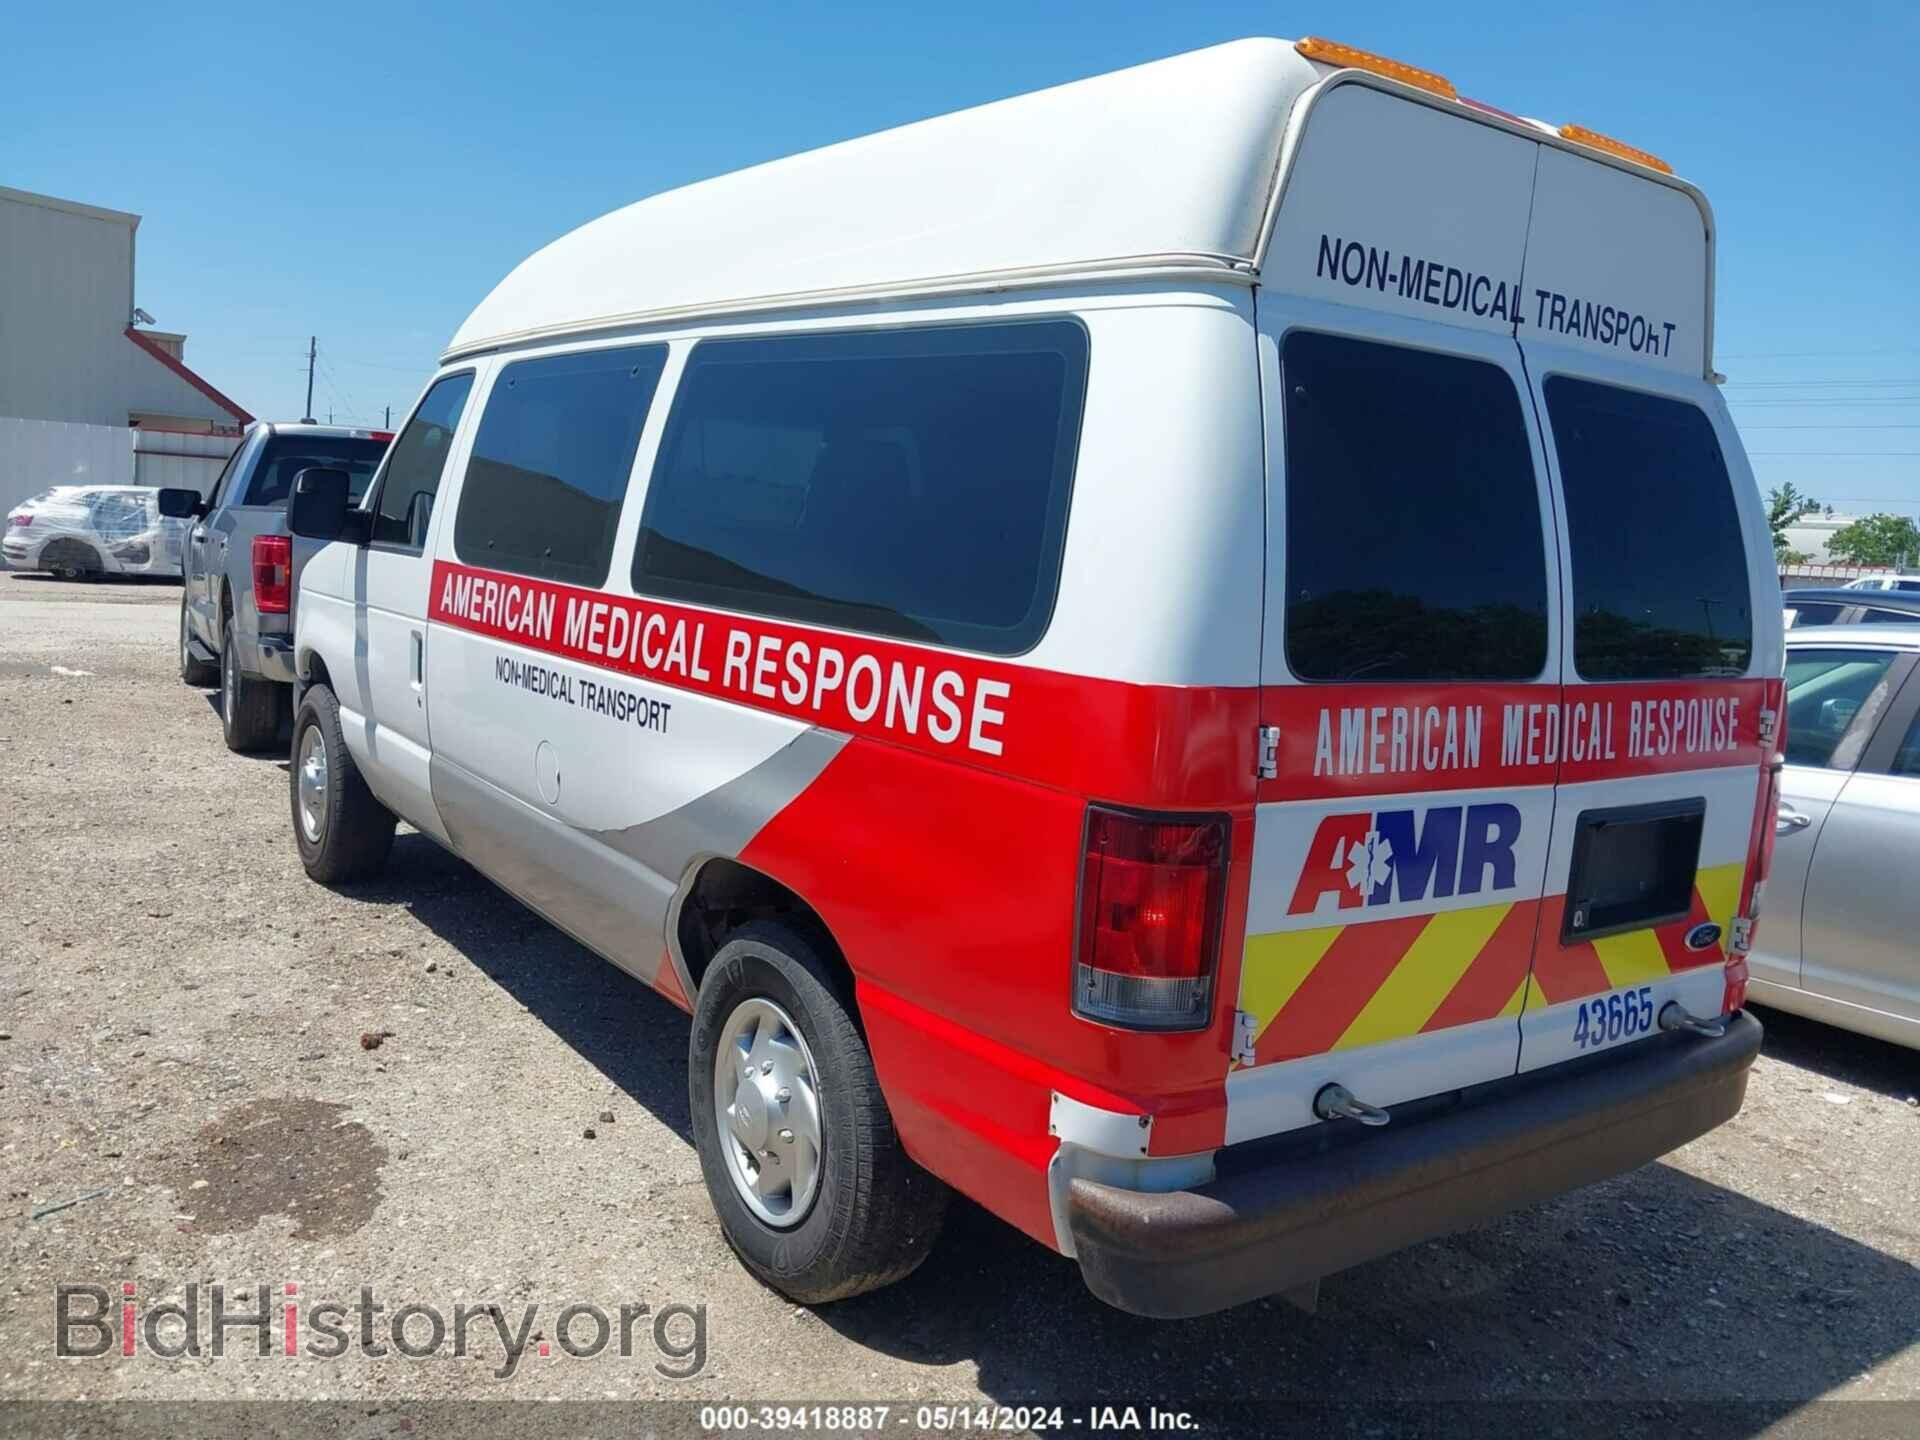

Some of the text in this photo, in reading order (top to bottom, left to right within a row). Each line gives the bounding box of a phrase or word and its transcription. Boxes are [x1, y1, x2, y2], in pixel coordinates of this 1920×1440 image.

[1316, 234, 1525, 324] NON-MEDICAL
[440, 572, 1011, 756] AMERICAN MEDICAL RESPONSE
[495, 656, 671, 733] NON-MEDICAL TRANSPORT
[1313, 697, 1740, 776] AMERICAN MEDICAL RESPONSE
[1286, 803, 1522, 916] AMR
[1572, 987, 1654, 1049] 43665
